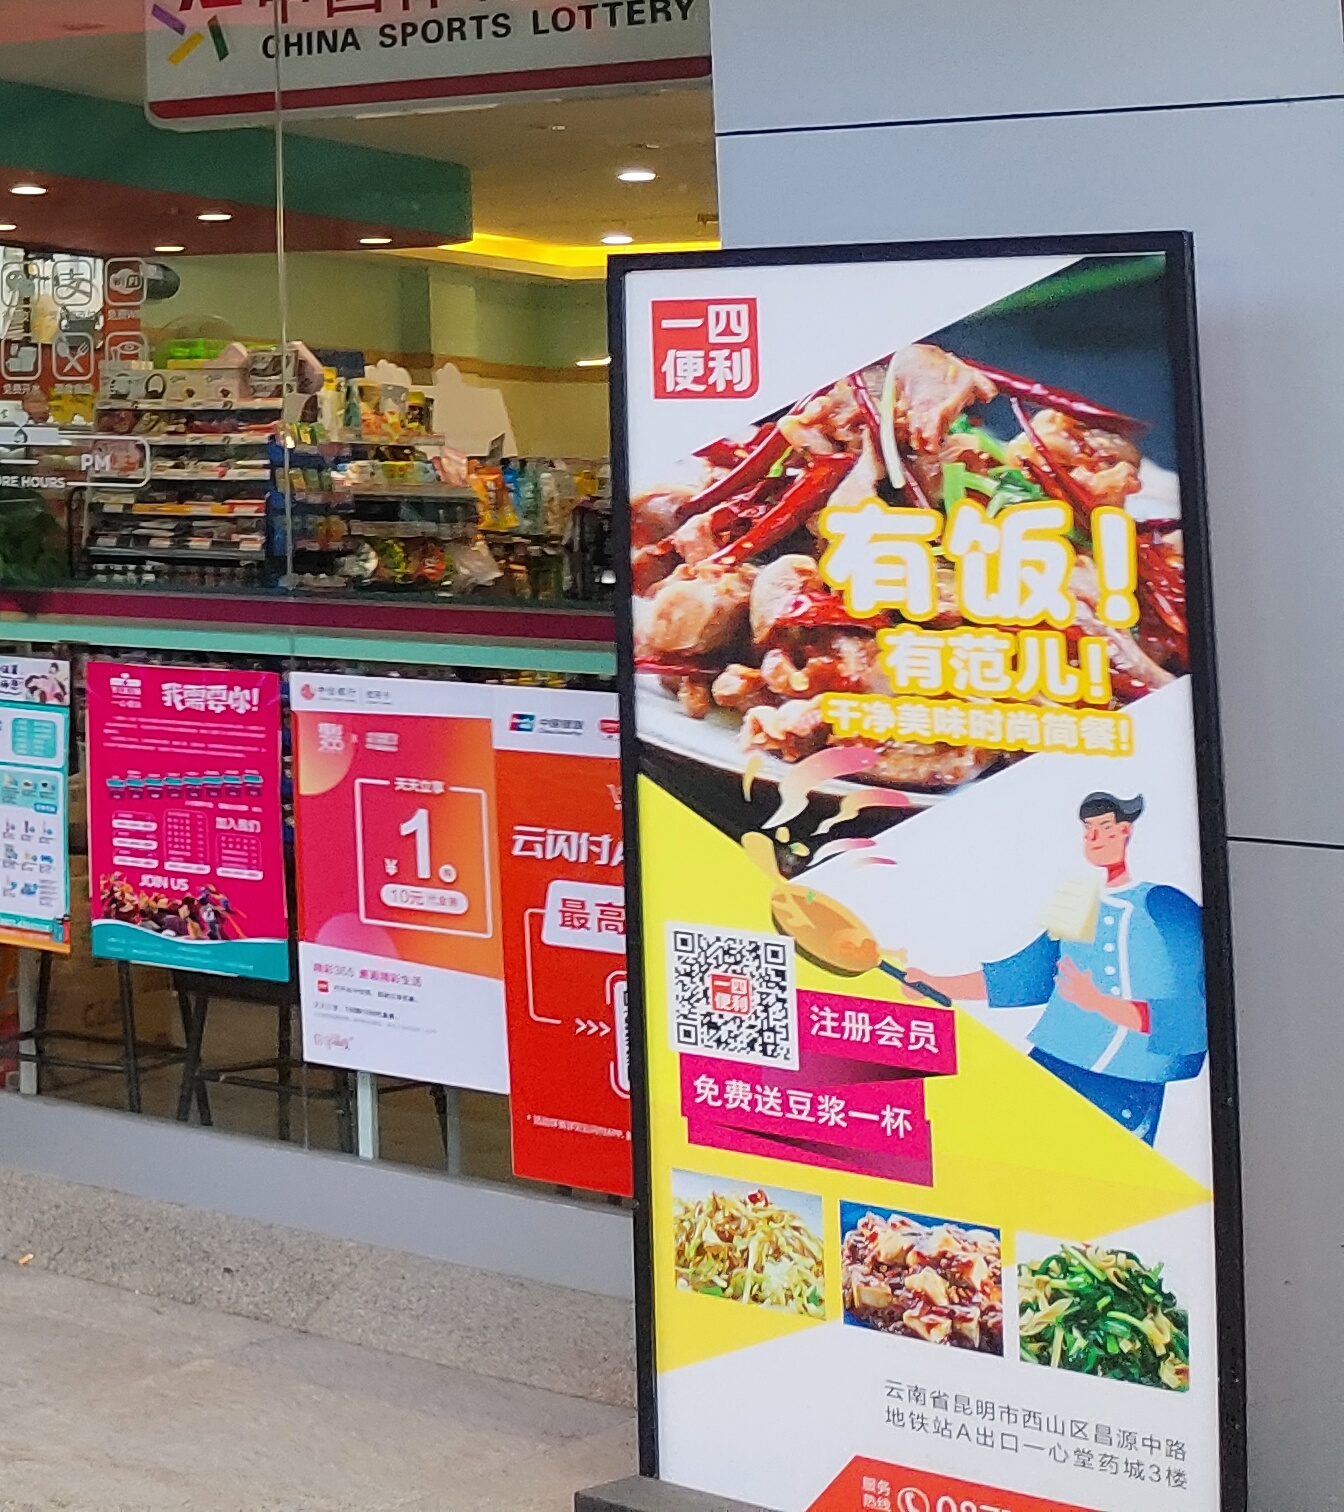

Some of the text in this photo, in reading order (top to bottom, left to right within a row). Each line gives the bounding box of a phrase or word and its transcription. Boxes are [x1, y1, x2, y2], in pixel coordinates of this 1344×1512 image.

[261, 27, 361, 60] CHINA
[378, 12, 513, 49] SPORTS
[660, 303, 750, 344] 一四
[661, 348, 751, 393] 便利
[21, 475, 66, 489] HOURS
[81, 455, 111, 472] PM
[824, 502, 1138, 625] 有饭!
[884, 631, 1111, 702] 有范儿!
[161, 682, 260, 714] 我需要你!
[827, 701, 1133, 753] 干净美味时尚简餐!
[139, 874, 190, 891] JOIN US
[810, 1005, 940, 1054] 注册会员
[692, 1074, 914, 1139] 免费送豆浆一杯
[884, 1379, 1187, 1462] 云南省昆明市西山区昌源中路
[885, 1405, 1187, 1490] 地铁站A出口一心堂药城3楼
